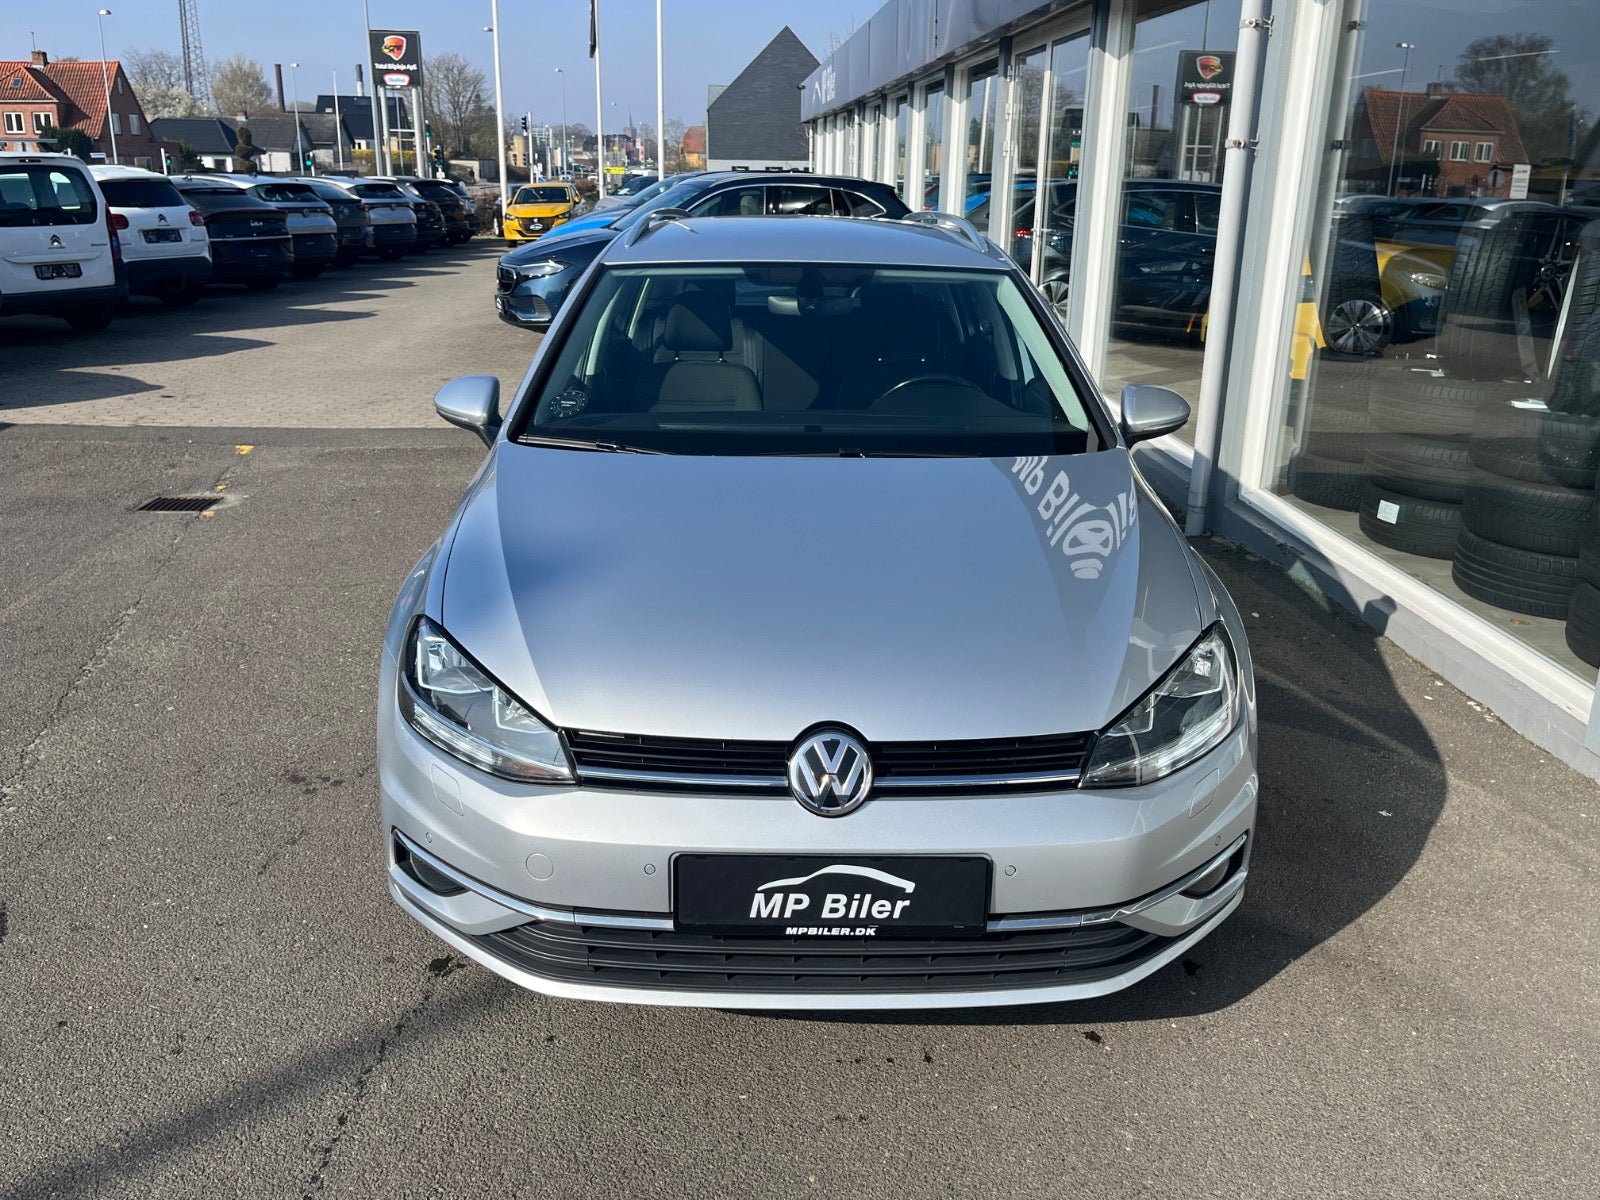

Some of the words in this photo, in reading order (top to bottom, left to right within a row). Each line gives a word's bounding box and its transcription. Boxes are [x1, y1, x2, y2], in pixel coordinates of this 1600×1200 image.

[749, 892, 810, 919] MP
[821, 893, 911, 919] Biler
[785, 927, 877, 936] MPBILER.DK
